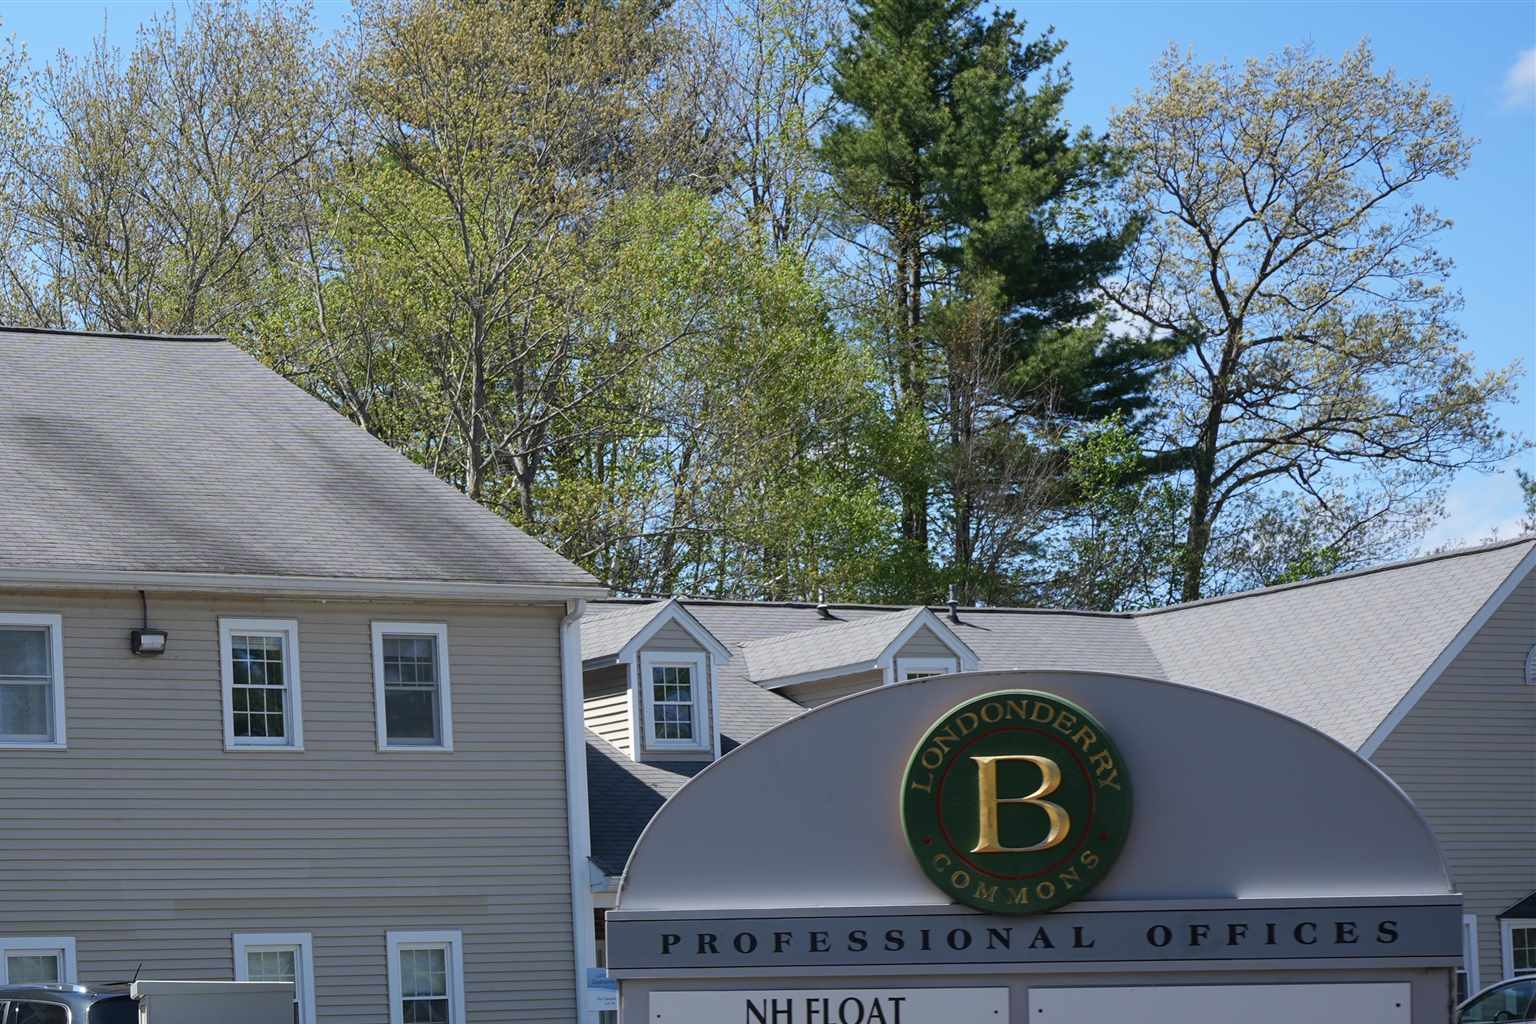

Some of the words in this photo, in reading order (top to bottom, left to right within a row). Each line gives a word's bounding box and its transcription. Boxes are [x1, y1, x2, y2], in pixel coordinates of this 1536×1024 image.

[911, 699, 1121, 794] LONDONDERRY
[969, 754, 1072, 853] B
[933, 850, 1099, 905] COMMONS
[660, 926, 1096, 955] PROFESSIONAL
[1146, 920, 1400, 948] OFFICES
